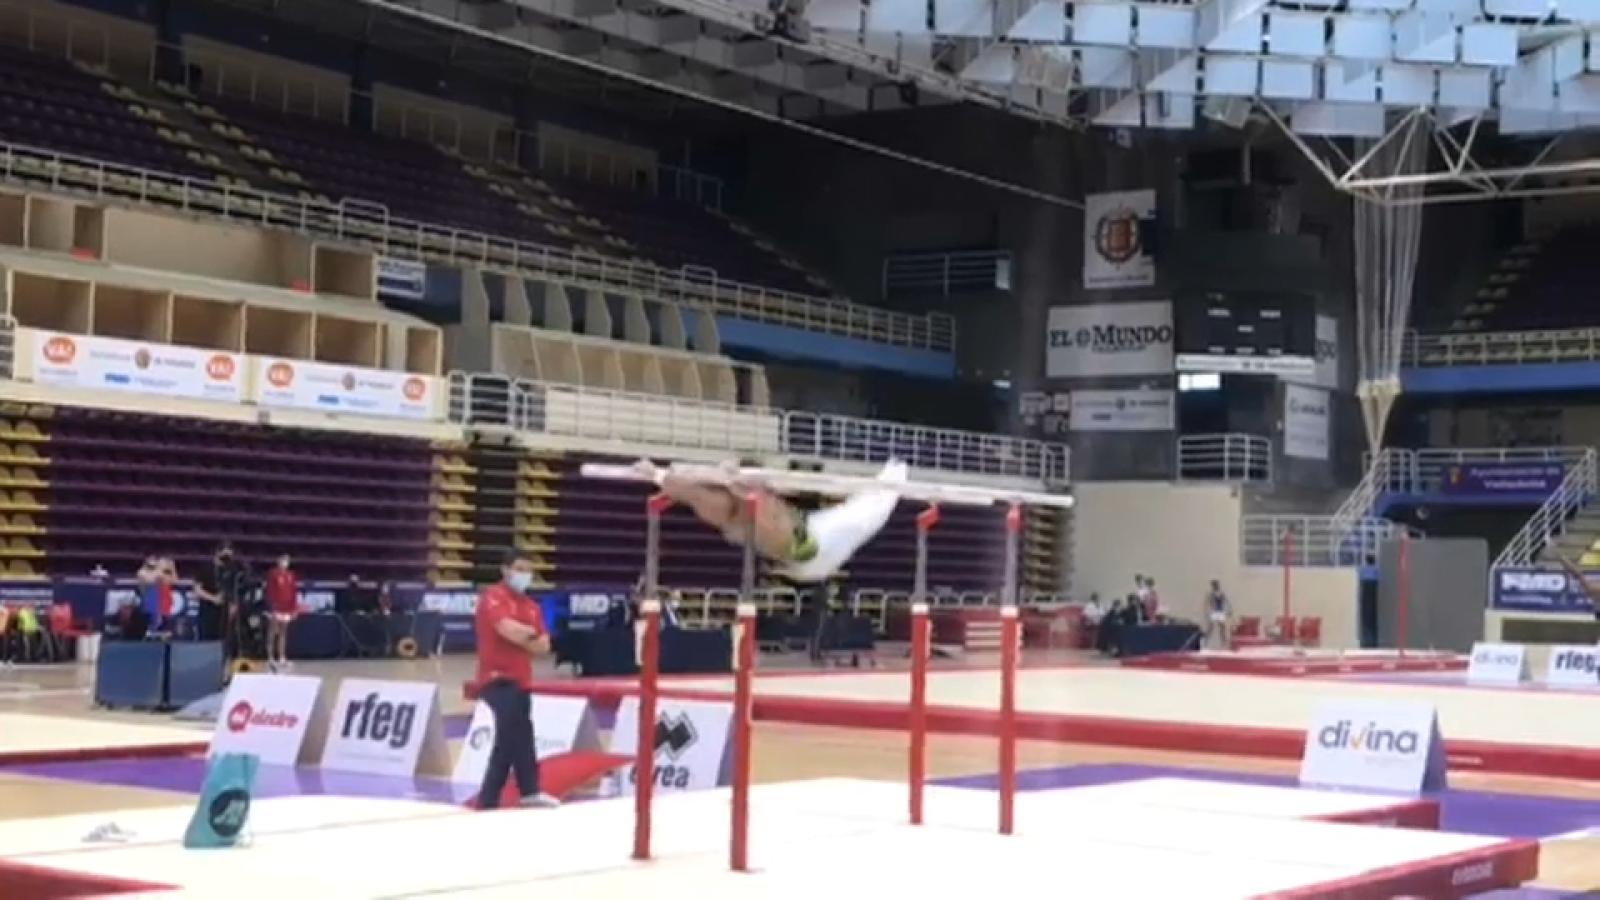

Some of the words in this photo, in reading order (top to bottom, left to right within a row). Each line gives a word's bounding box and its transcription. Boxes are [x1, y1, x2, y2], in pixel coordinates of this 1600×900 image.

[1092, 324, 1172, 346] MUNDO
[342, 692, 416, 748] rfeg
[1318, 719, 1418, 754] divina
[630, 763, 690, 788] erea
